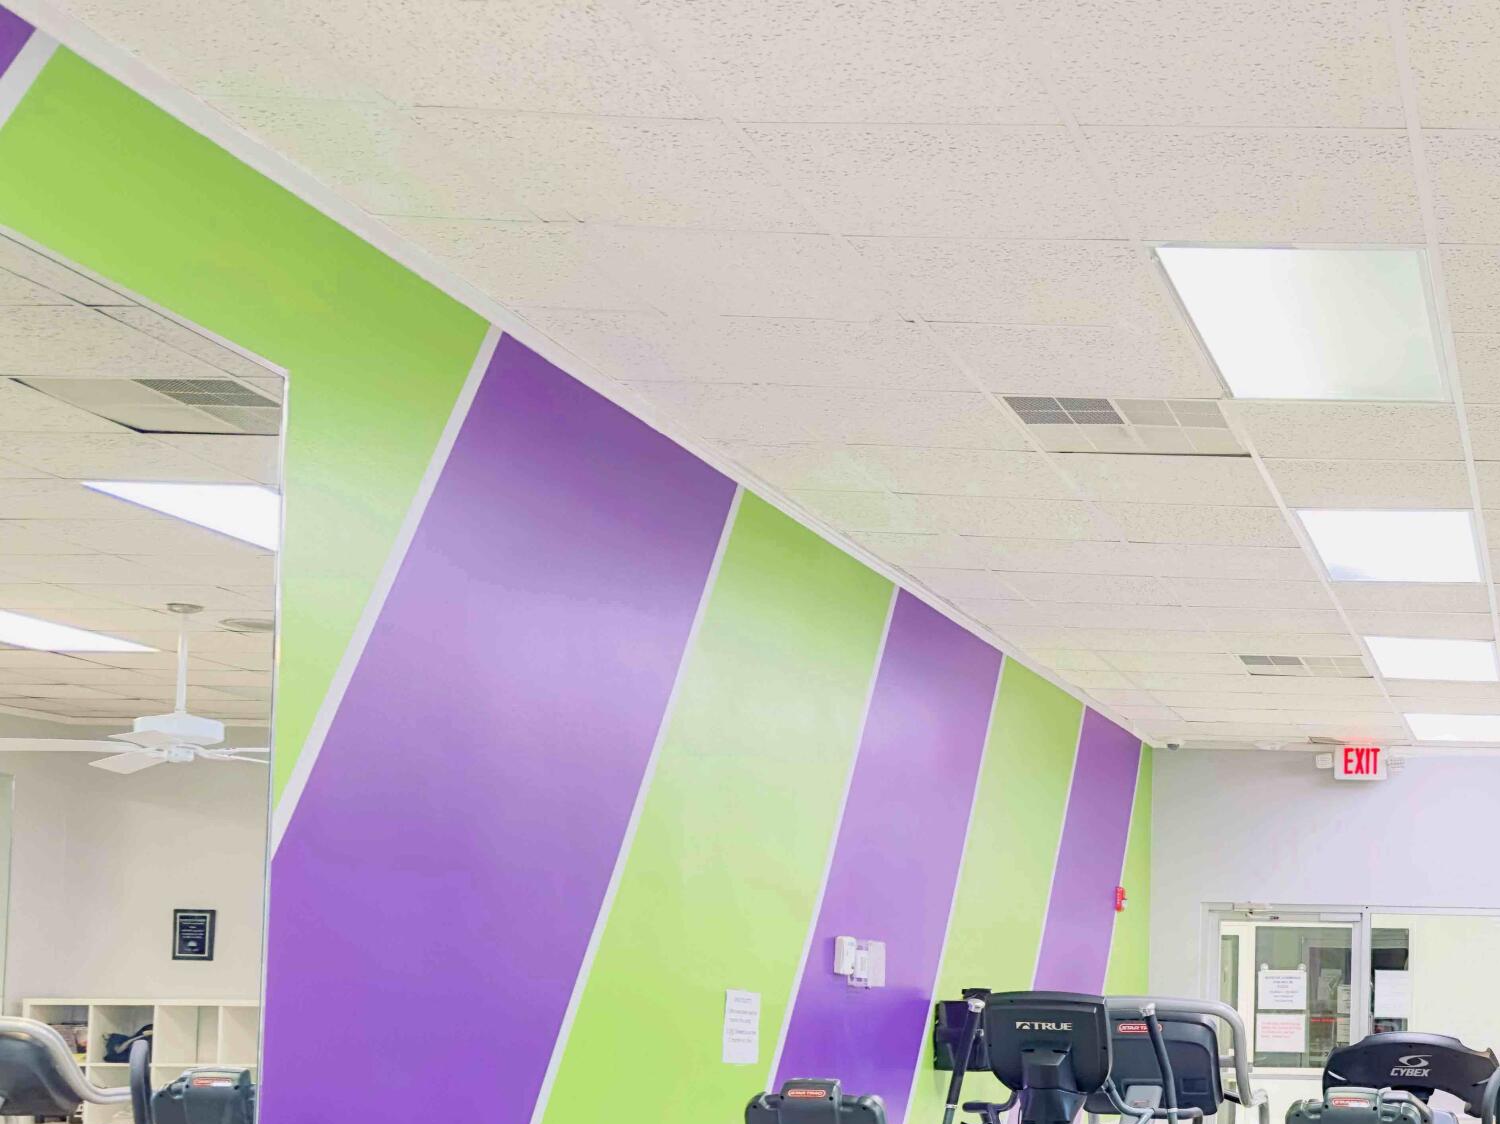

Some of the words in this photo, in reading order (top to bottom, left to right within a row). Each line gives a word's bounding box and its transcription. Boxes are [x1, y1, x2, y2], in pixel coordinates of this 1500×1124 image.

[1344, 748, 1380, 774] EXIT
[1031, 1022, 1073, 1031] TRUE
[1390, 1068, 1432, 1077] CYBEX
